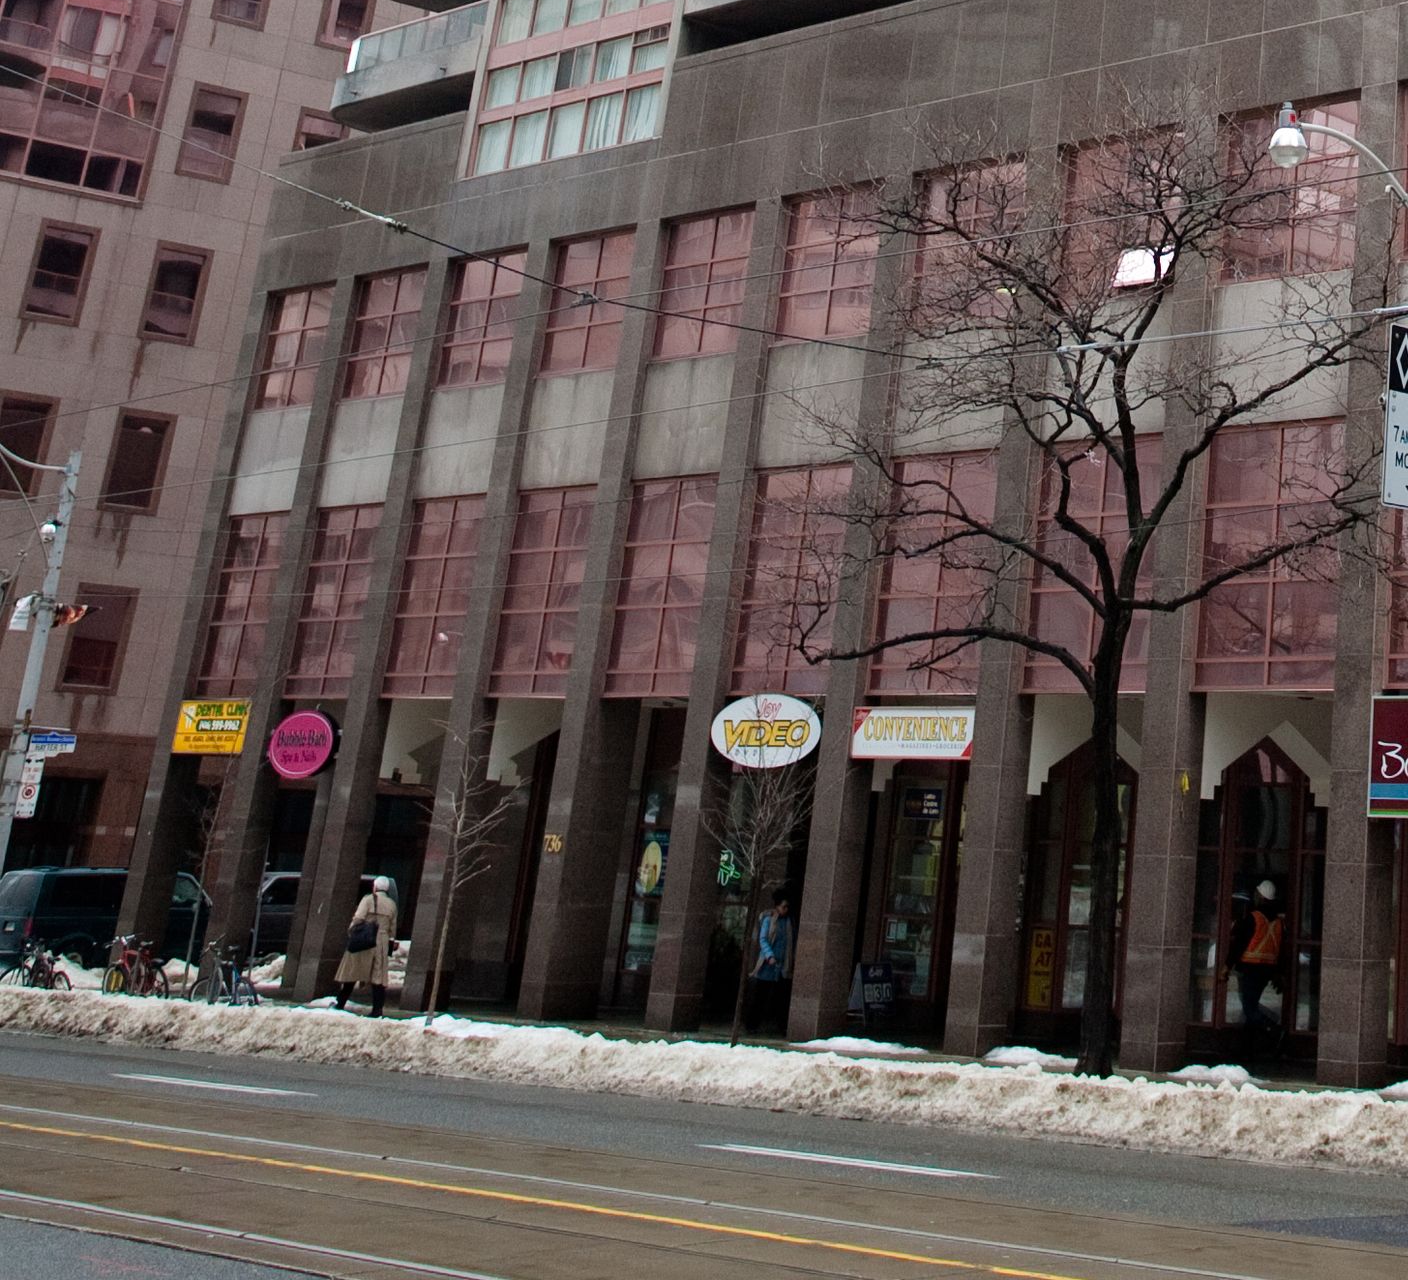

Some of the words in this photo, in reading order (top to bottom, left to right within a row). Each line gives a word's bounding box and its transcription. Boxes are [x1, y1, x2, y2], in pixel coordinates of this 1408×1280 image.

[723, 719, 811, 755] VIDEO
[863, 715, 968, 742] CONVENIENCE
[543, 834, 563, 853] 736
